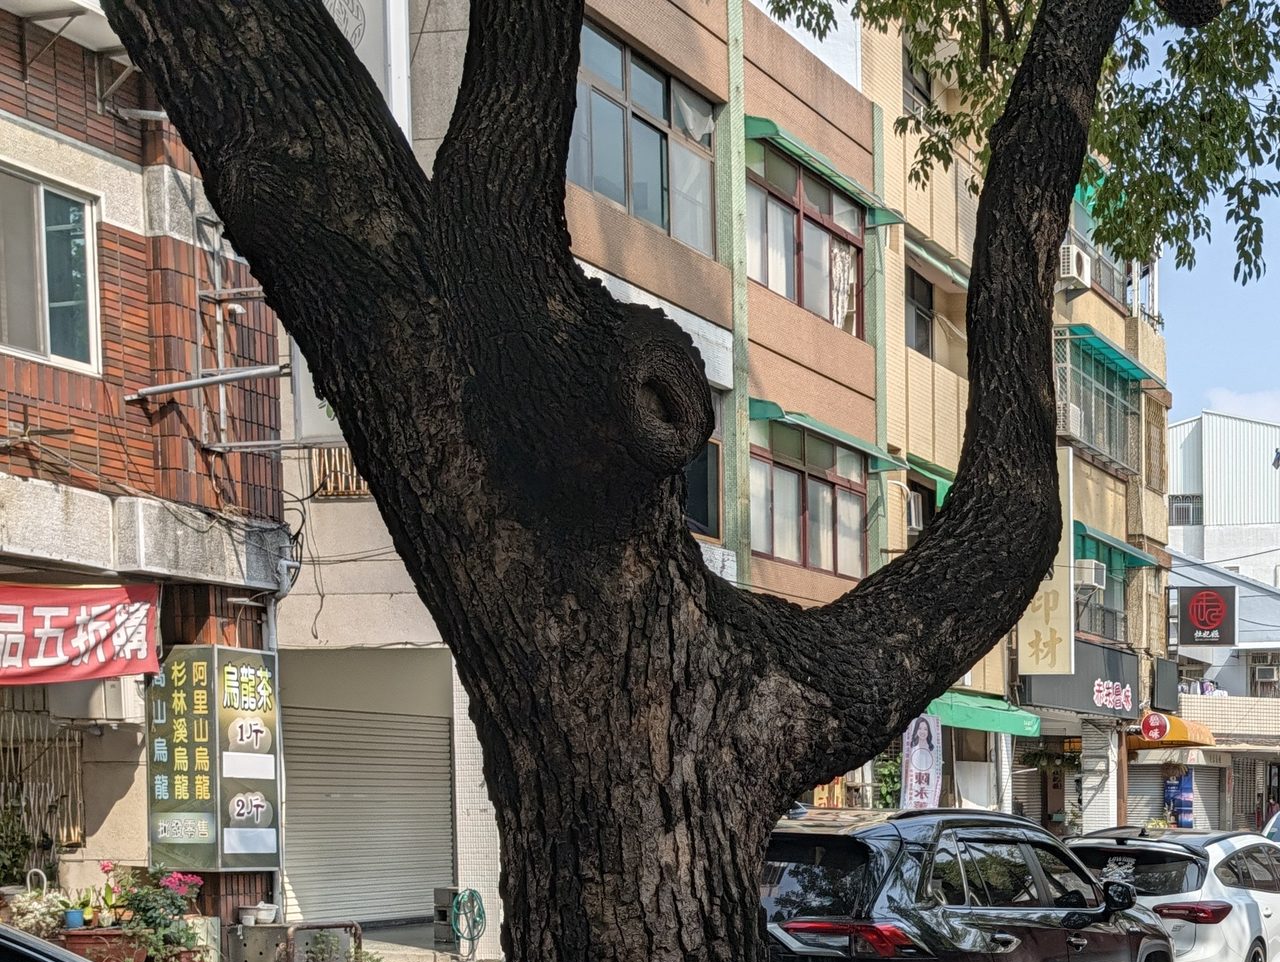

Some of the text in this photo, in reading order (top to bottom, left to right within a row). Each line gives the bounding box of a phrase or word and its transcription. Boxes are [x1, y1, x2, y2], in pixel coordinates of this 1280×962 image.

[0, 602, 150, 668] 品五折購
[1028, 589, 1063, 669] 印材
[223, 662, 273, 712] 烏龍茶
[152, 664, 170, 800] 高山烏龍
[171, 661, 190, 800] 杉林溪烏龍
[192, 661, 211, 800] 阿里山烏龍
[238, 722, 264, 747] 1斤
[158, 819, 209, 839] 批發零售
[236, 798, 264, 823] 2斤
